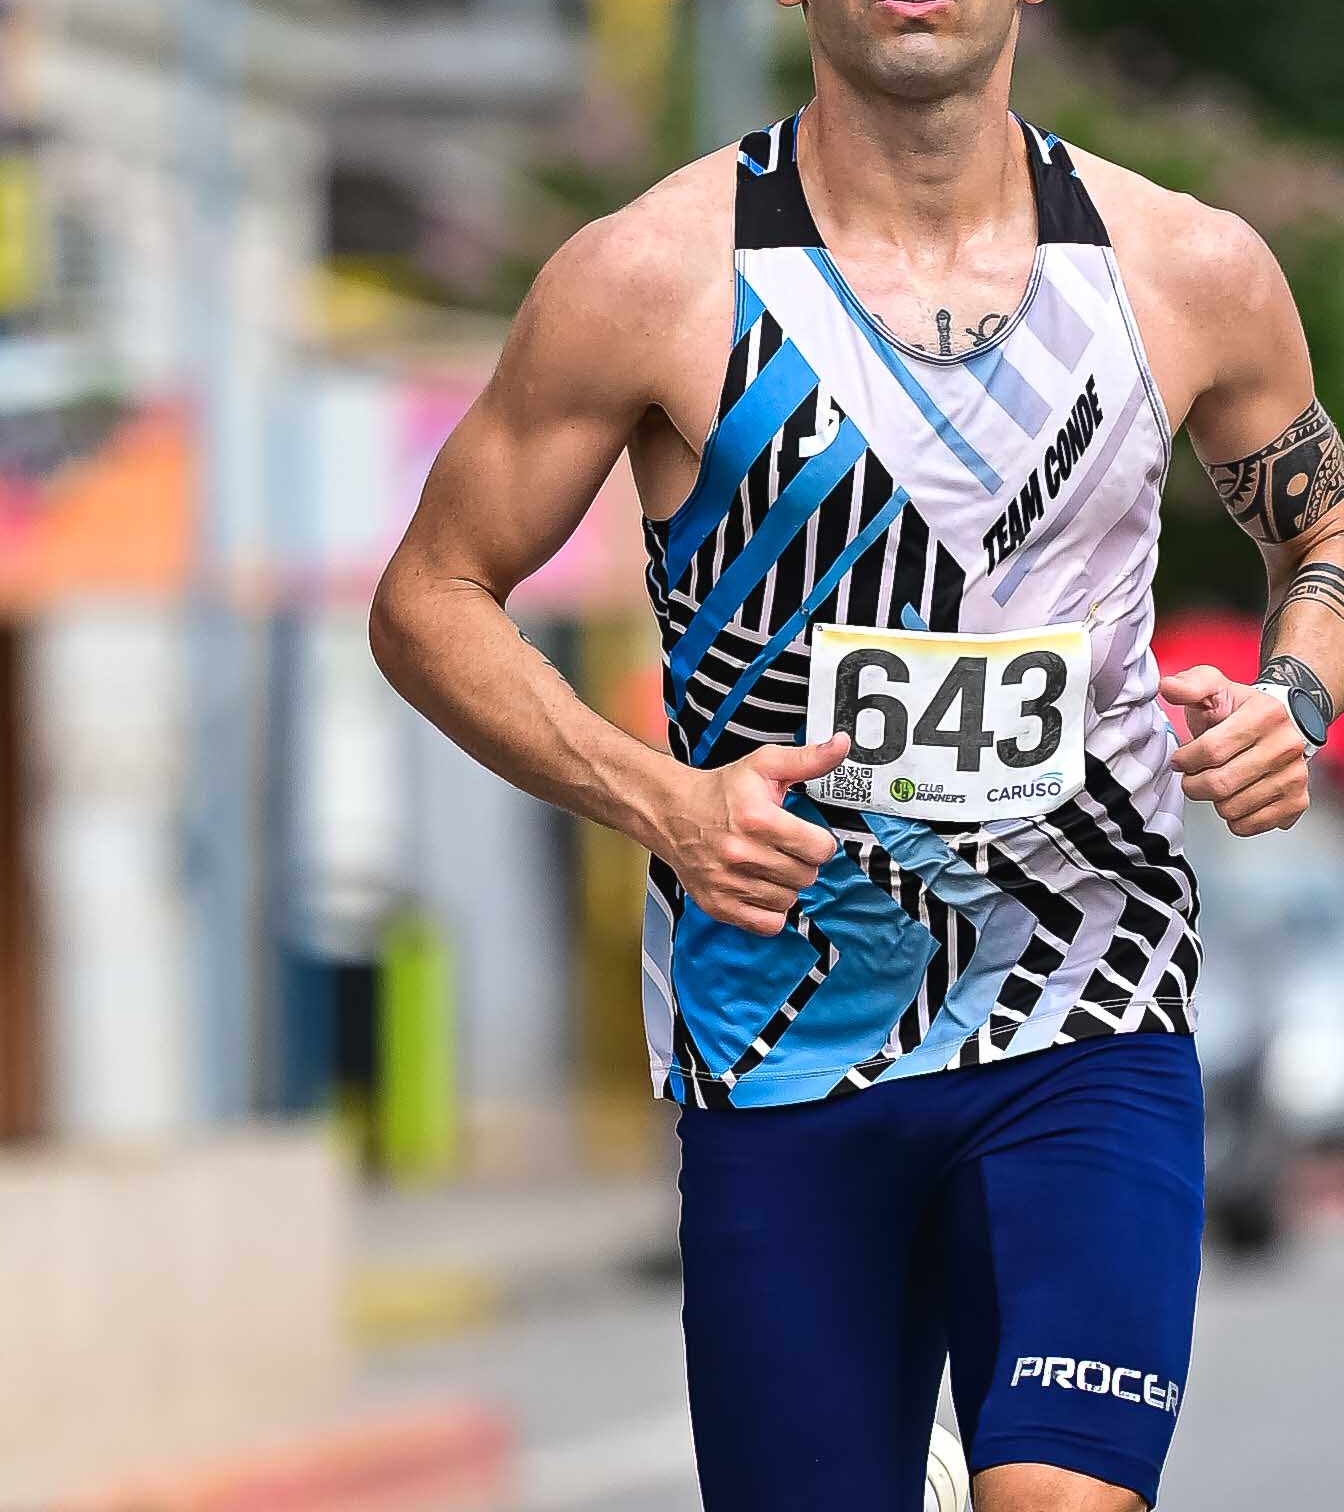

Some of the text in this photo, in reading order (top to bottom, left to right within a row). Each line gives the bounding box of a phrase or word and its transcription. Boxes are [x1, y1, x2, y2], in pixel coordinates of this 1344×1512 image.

[982, 373, 1104, 577] TEAM CONDE
[832, 648, 1068, 773] 643
[986, 781, 1062, 803] CARUSO
